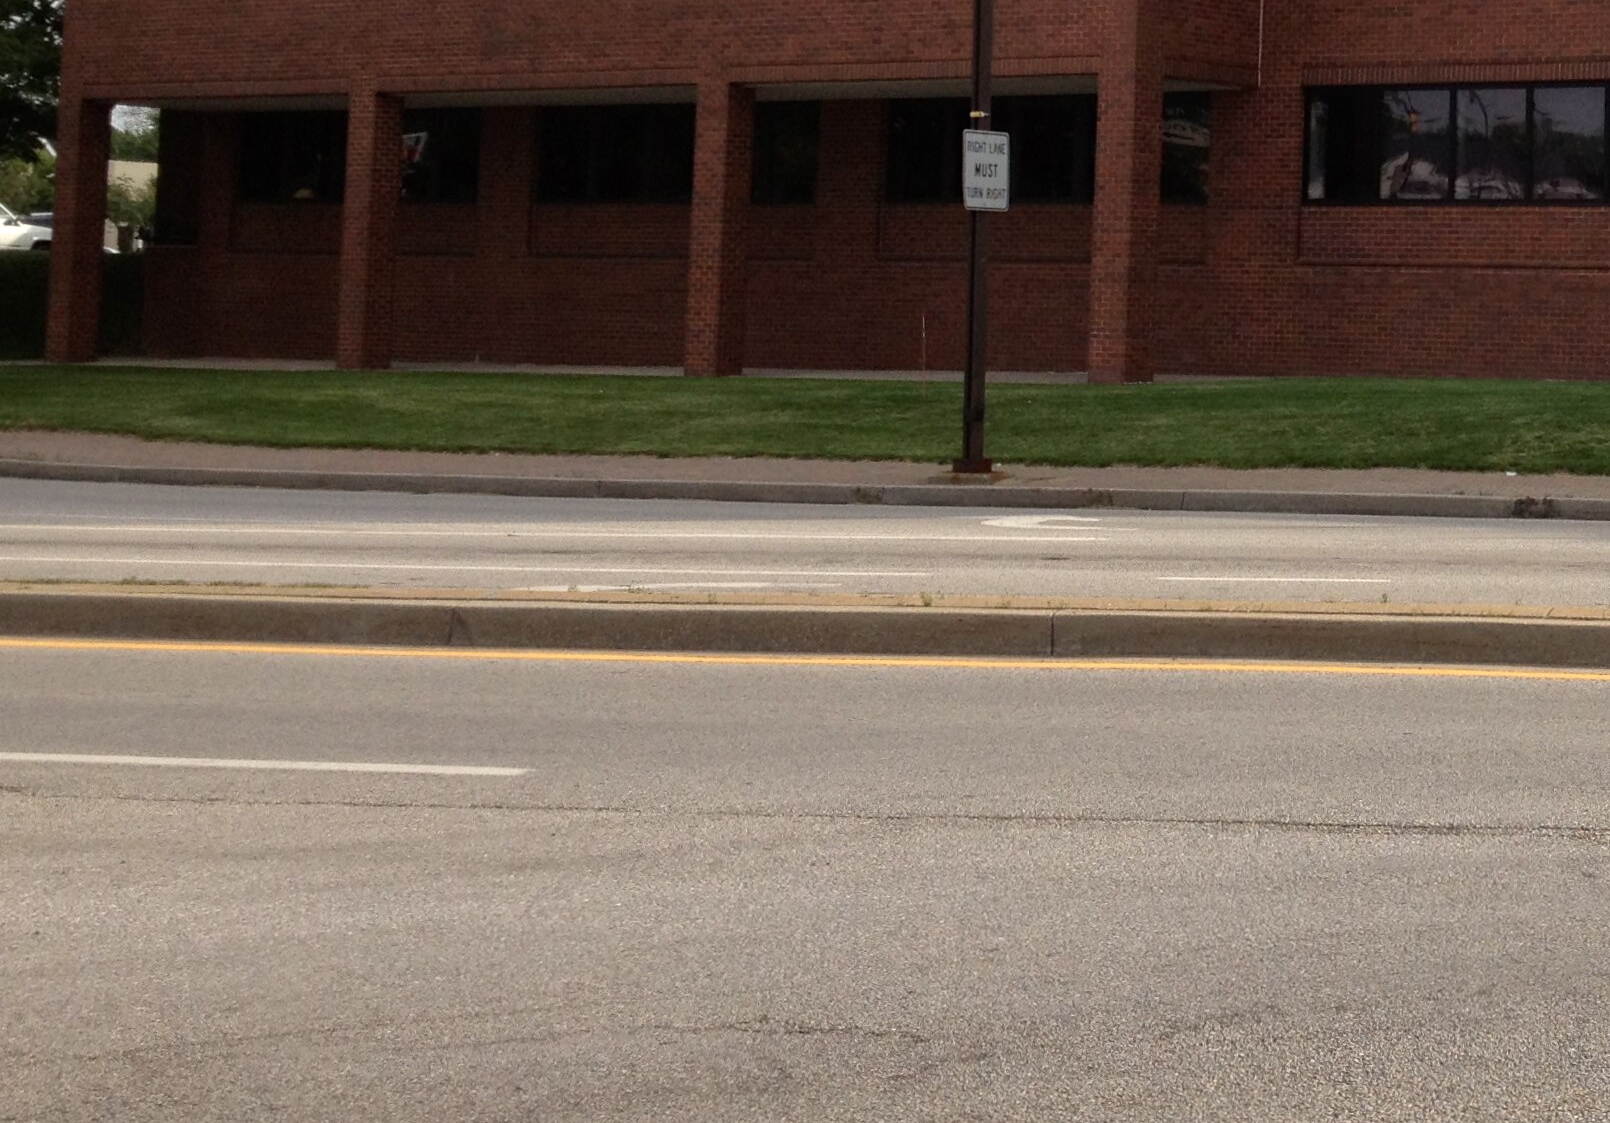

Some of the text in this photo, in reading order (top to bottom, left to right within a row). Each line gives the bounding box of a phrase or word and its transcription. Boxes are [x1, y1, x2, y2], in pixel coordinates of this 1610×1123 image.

[967, 141, 1006, 155] RIGHT LANE
[975, 163, 998, 178] MUST
[966, 186, 1006, 200] TURN RIGHT
